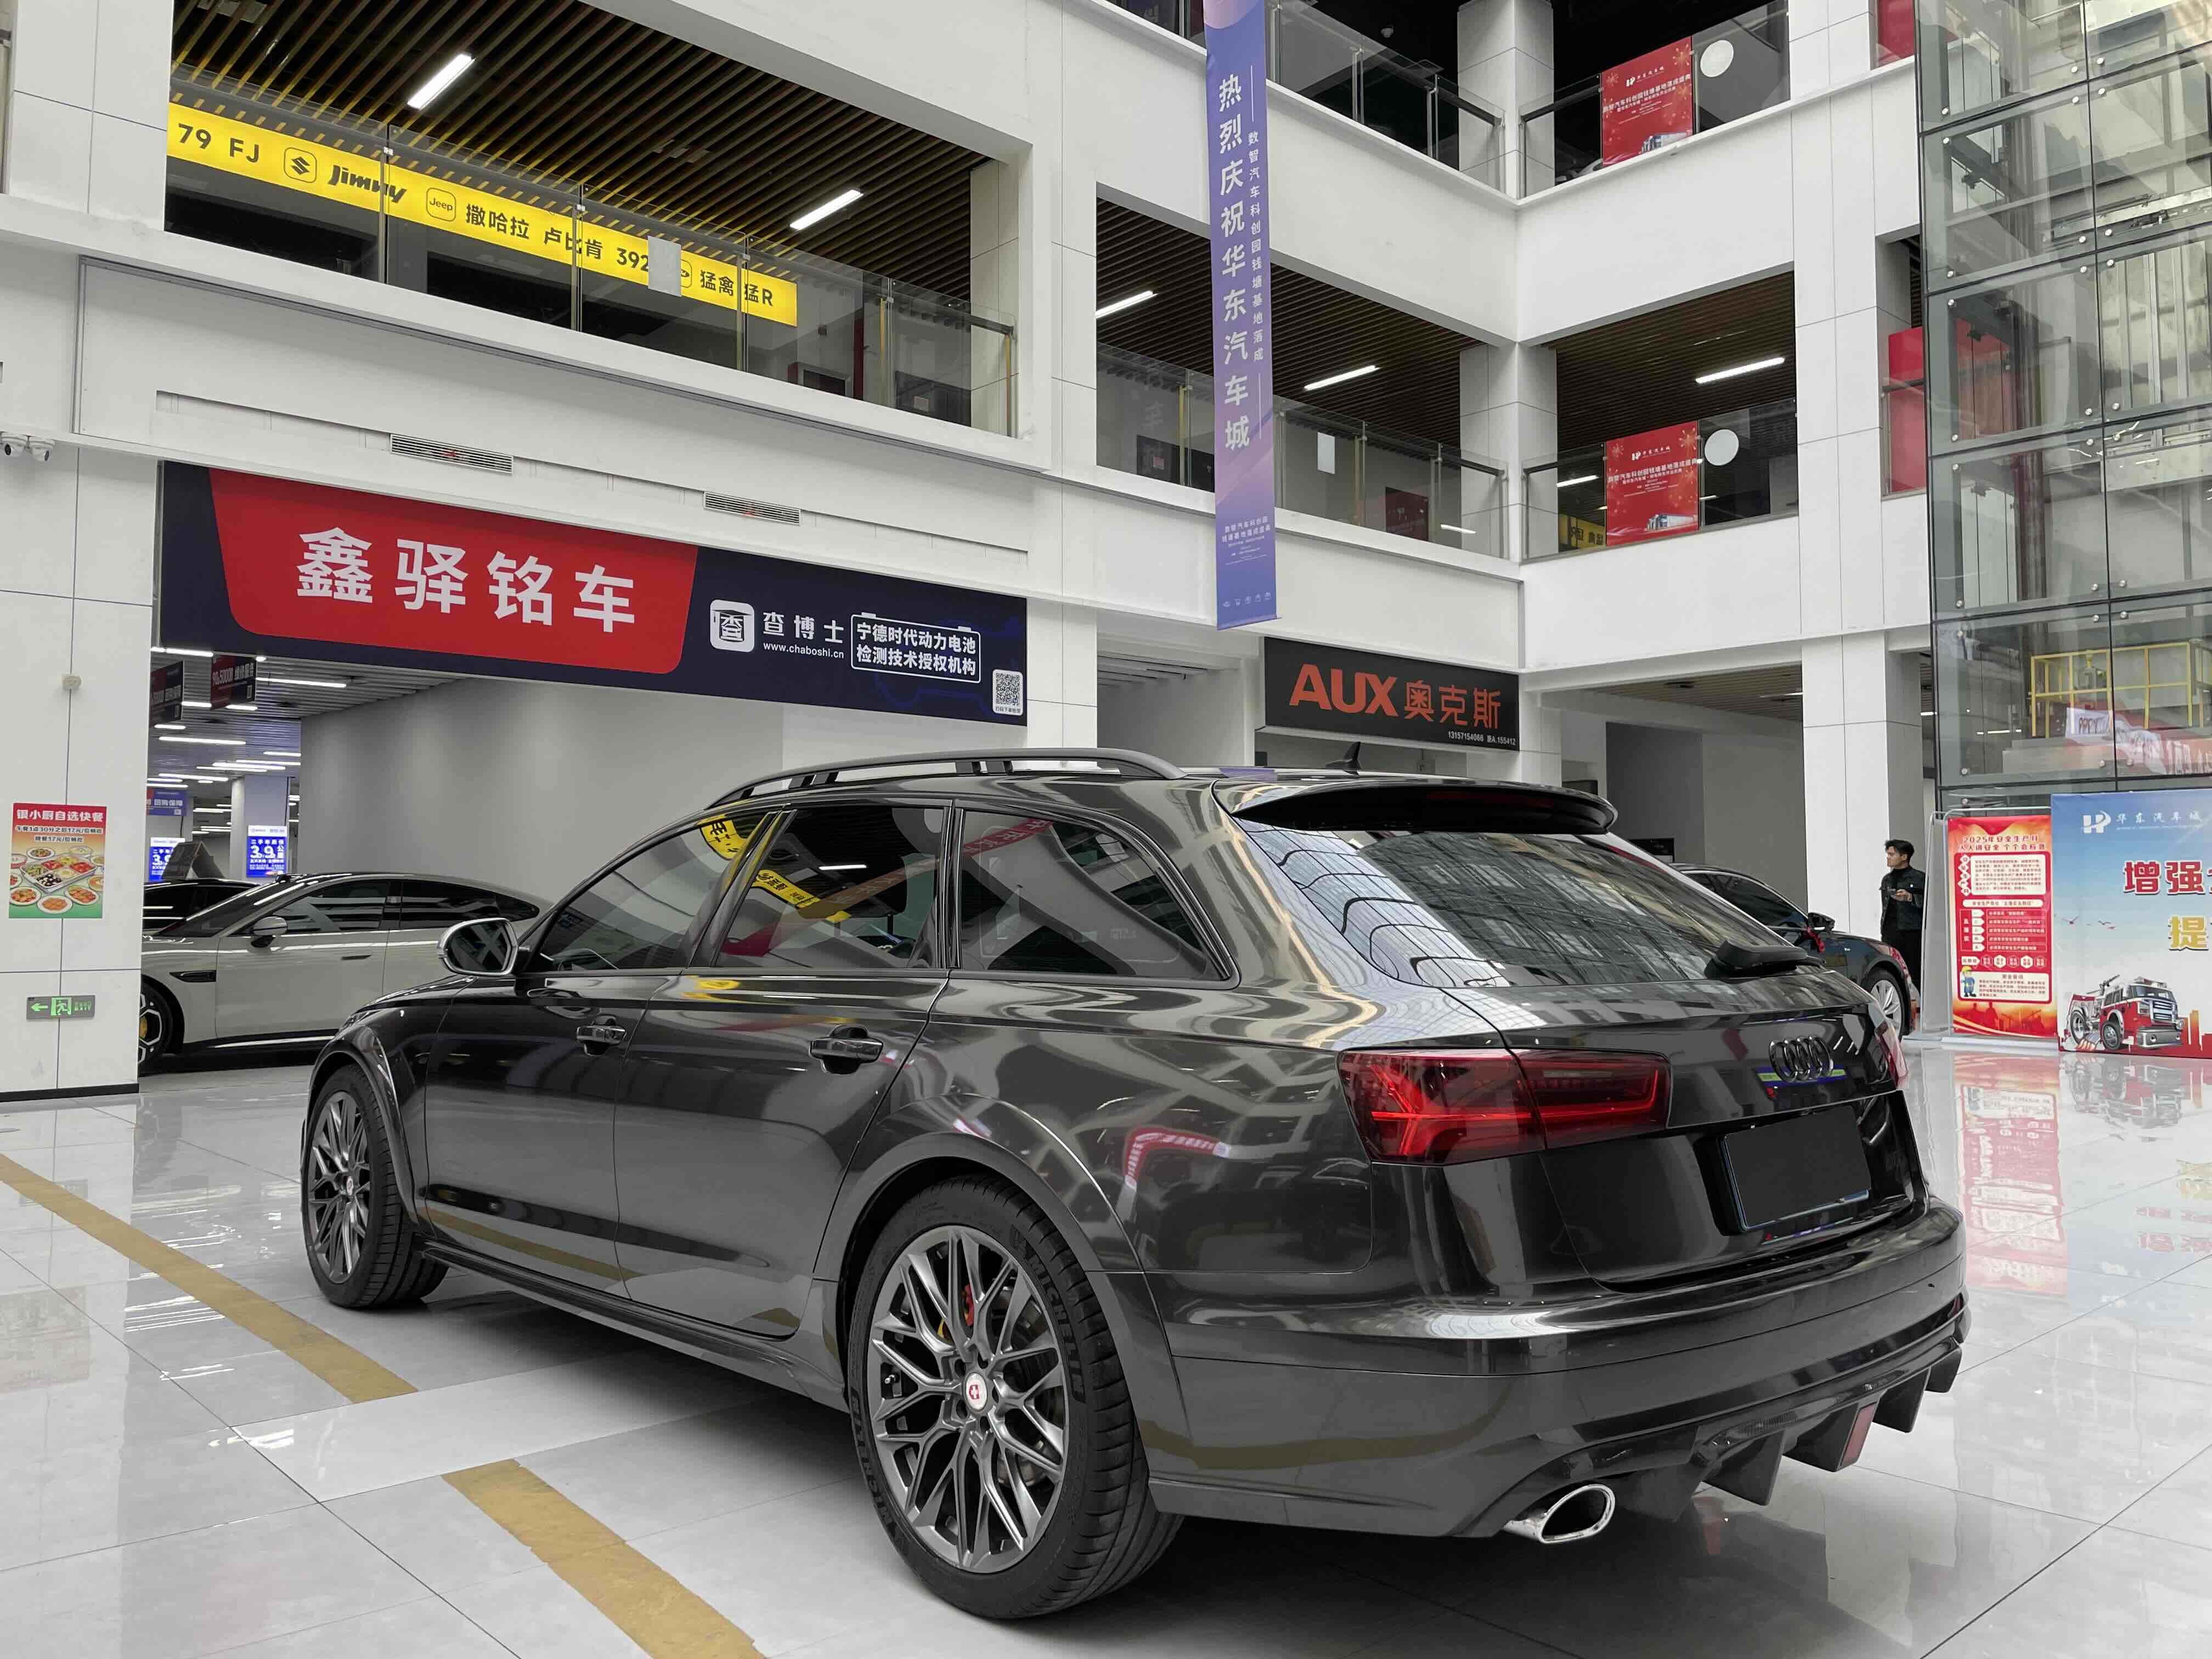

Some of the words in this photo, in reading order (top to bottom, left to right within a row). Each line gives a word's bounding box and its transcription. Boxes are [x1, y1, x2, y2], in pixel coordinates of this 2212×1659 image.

[178, 123, 211, 149] 79
[229, 137, 260, 163] FJ
[428, 196, 453, 212] Jeep
[466, 204, 530, 240] 撒哈拉
[1219, 74, 1250, 450] 热烈庆祝华东汽车城
[699, 269, 734, 297] 猛禽
[744, 283, 774, 307] 猛R
[296, 526, 635, 633] 鑫驿铭车
[763, 611, 844, 644] 查博士
[856, 622, 976, 654] 宁德时代动力电池
[763, 642, 844, 659] www.chaboshi.cn
[856, 645, 976, 676] 检测技术授权机构
[1289, 663, 1400, 717] AUX
[1404, 679, 1502, 730] 奥克斯
[2124, 860, 2212, 895] 增强
[2169, 915, 2212, 950] 提
